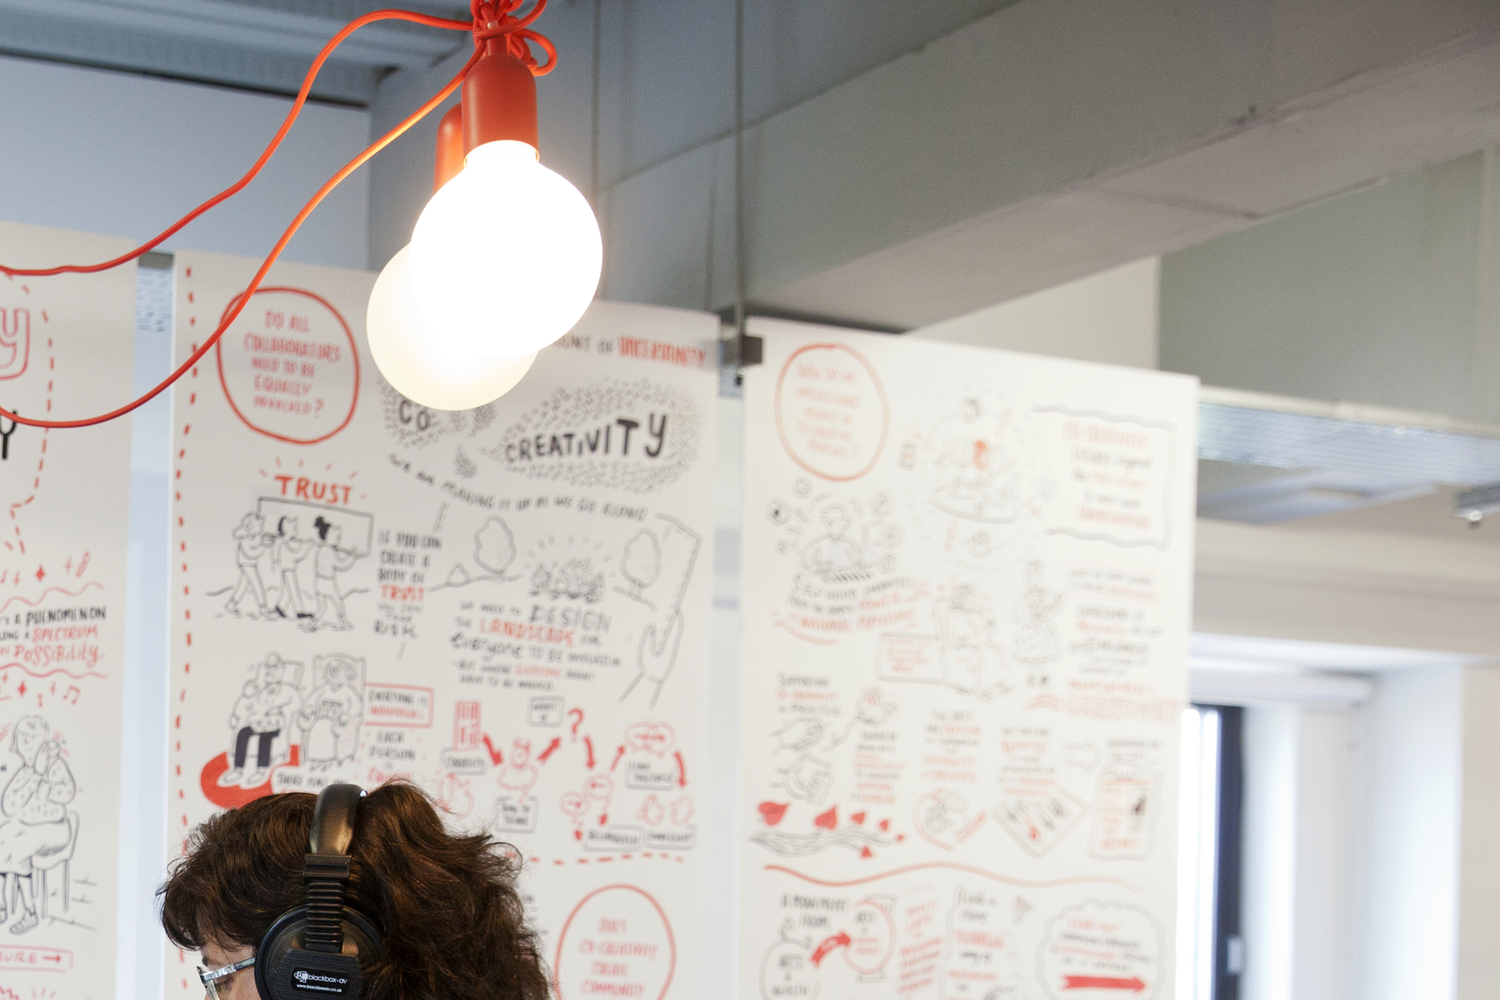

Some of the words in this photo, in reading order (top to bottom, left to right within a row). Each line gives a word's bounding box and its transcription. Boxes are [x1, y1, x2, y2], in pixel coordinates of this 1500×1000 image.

[504, 412, 668, 464] CREATIVITY
[274, 474, 353, 506] TRUST
[381, 584, 426, 602] TRUST
[479, 617, 576, 648] LANDSCAPE
[530, 604, 612, 632] DESIGN
[31, 624, 99, 643] SPECTRUM
